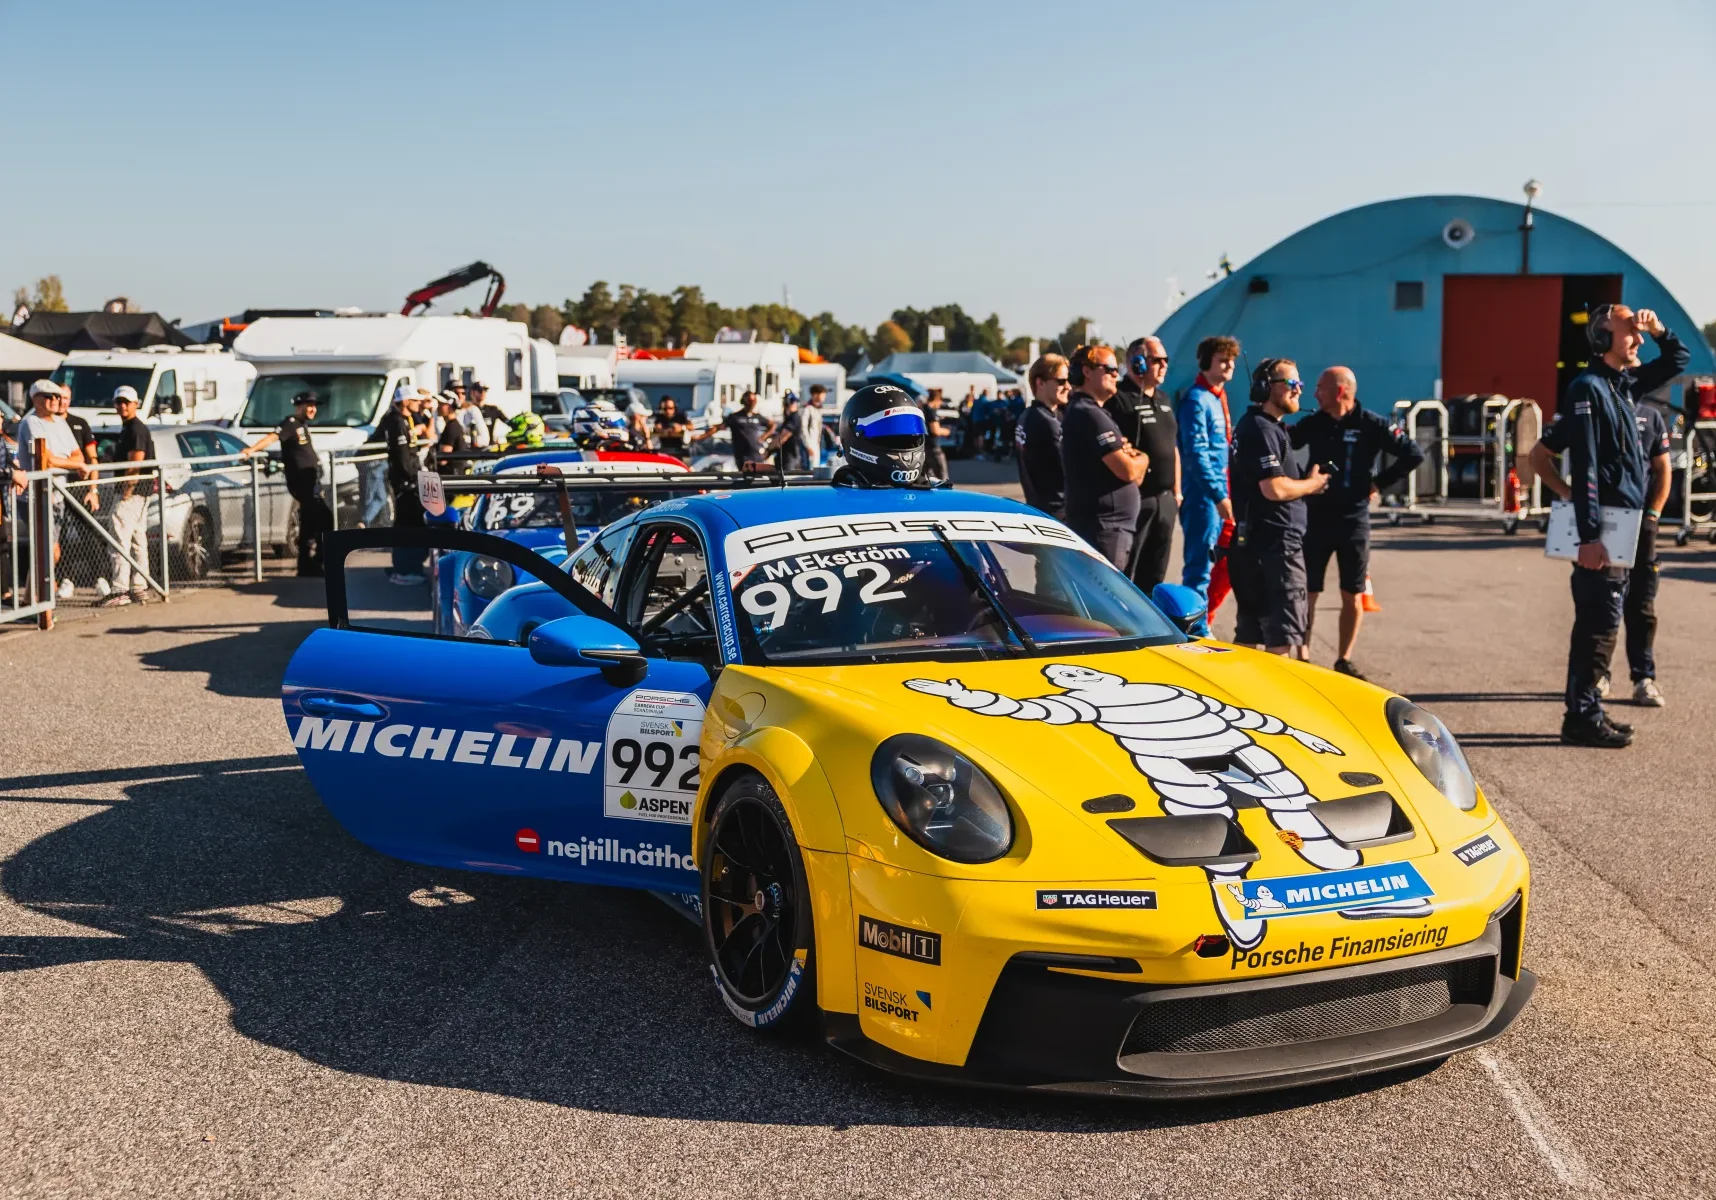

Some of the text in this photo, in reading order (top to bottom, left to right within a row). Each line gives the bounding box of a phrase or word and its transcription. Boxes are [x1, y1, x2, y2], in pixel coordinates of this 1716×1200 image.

[743, 519, 1077, 555] PORSCHE
[764, 545, 911, 581] M.Ekström
[740, 562, 907, 630] 992
[715, 571, 737, 661] www.carreracup.se
[635, 694, 690, 703] PORSCHE
[640, 728, 675, 737] BILSPORT
[641, 721, 669, 730] SVENSK
[294, 716, 602, 775] MICHELIN
[612, 738, 700, 791] 992
[639, 797, 689, 815] ASPEN
[1286, 874, 1410, 904] MICHELIN
[863, 921, 911, 955] Mobil
[1231, 924, 1449, 970] Porsche Finansiering
[757, 975, 797, 1025] MICHELIN
[864, 982, 908, 1007] SVENSK
[864, 995, 919, 1022] BILSPORT
